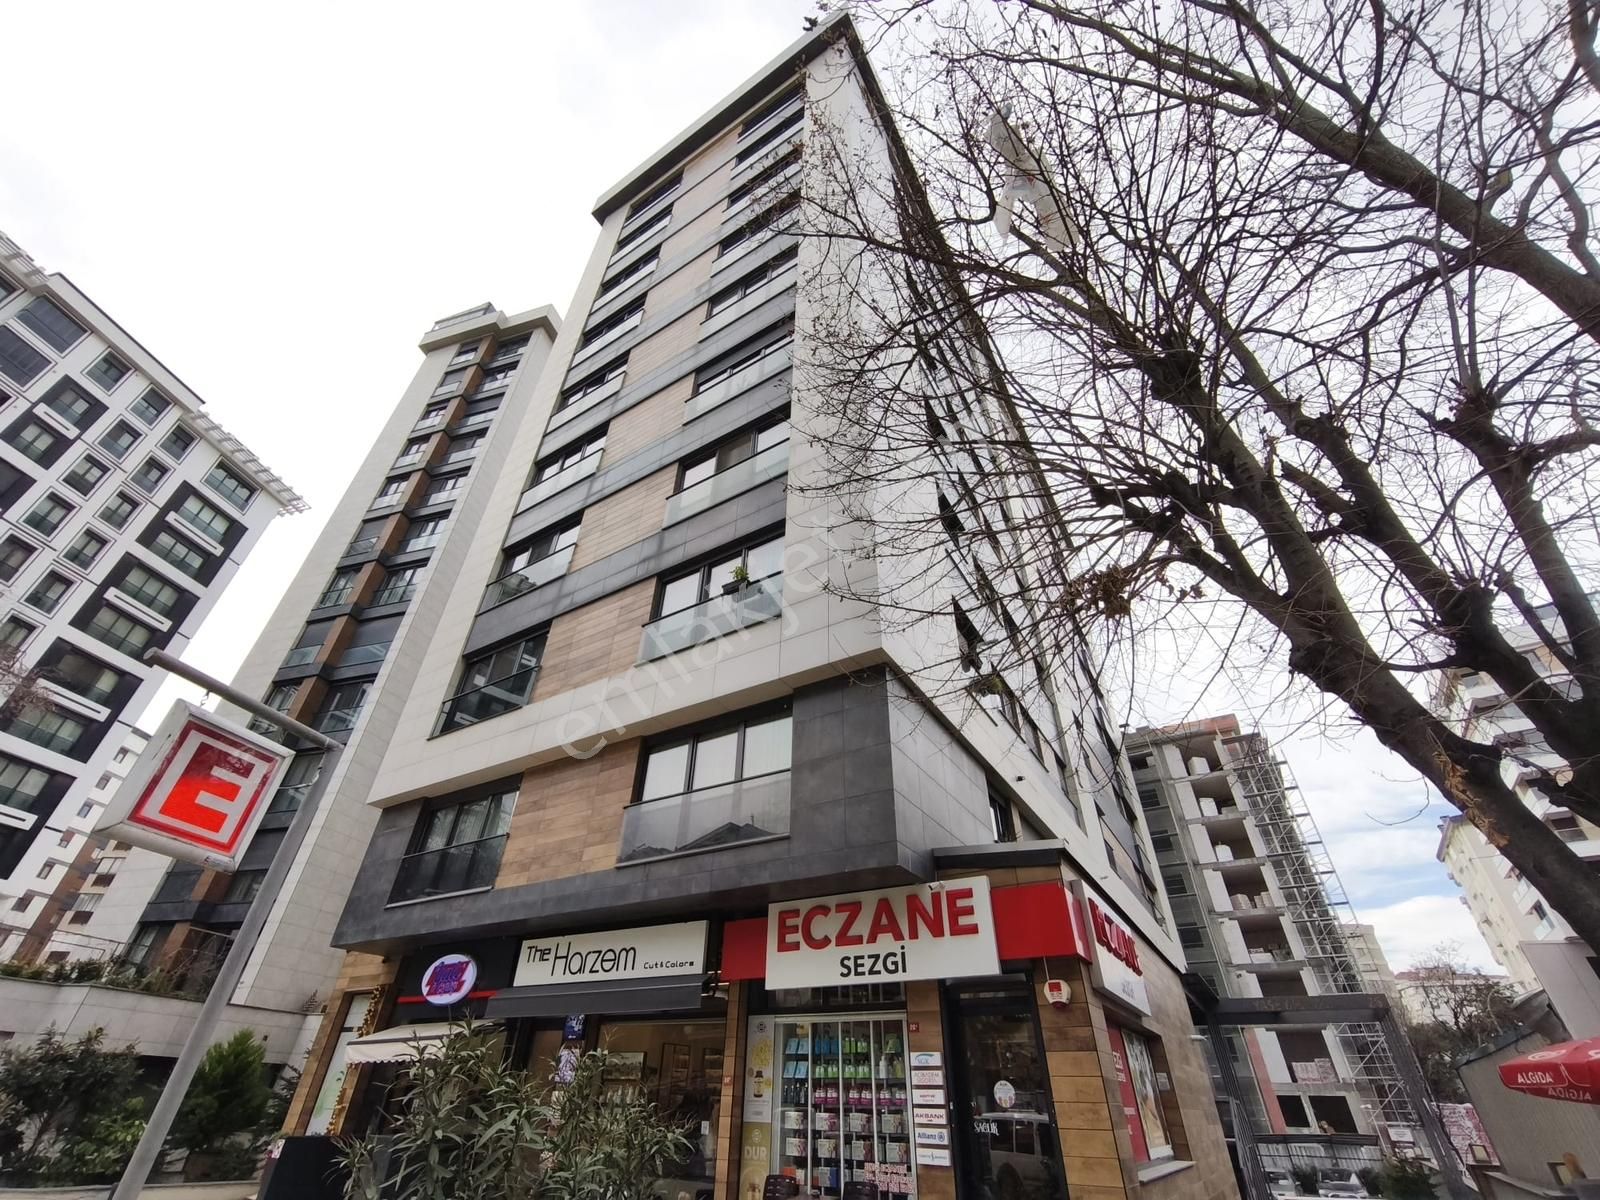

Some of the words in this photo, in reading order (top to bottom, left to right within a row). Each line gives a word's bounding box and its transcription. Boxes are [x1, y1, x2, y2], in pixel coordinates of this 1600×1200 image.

[159, 741, 255, 834] E
[777, 887, 979, 953] ECZANE
[527, 946, 552, 964] The
[551, 940, 637, 978] Harzem
[839, 945, 907, 978] SEZGİ
[915, 1112, 945, 1120] AKBANK
